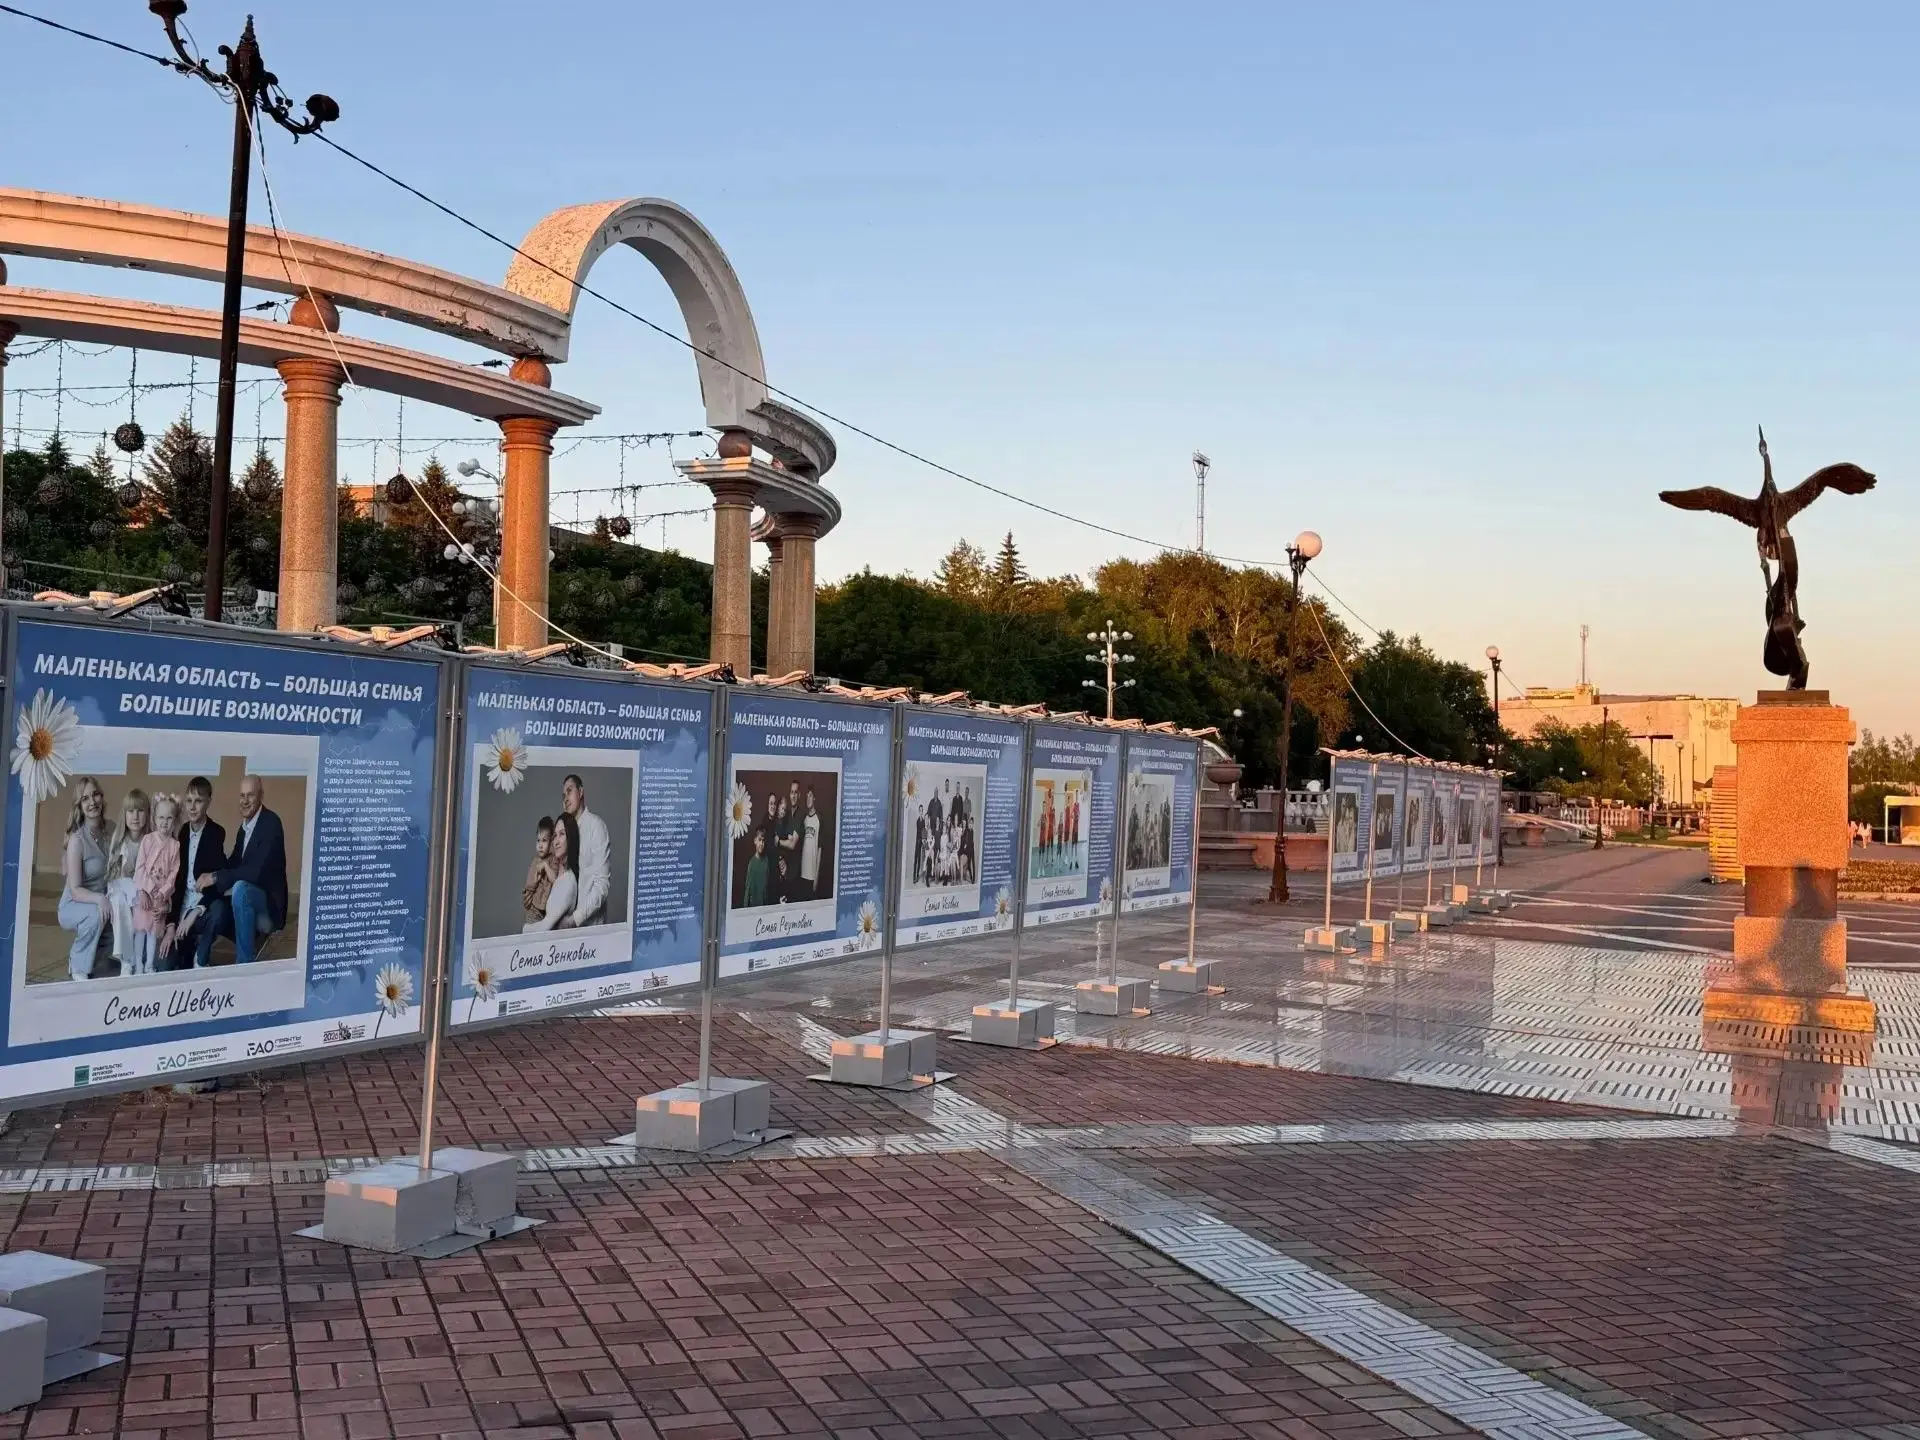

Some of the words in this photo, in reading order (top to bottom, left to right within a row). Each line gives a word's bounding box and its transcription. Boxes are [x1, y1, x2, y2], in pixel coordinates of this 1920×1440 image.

[33, 653, 171, 683] МАЛЕНЬКАЯ
[174, 666, 261, 690] ОБЛАСТЬ
[284, 675, 369, 698] БОЛЬШАЯ
[372, 683, 423, 702] СЕМЬЯ
[119, 693, 222, 718] БОЛЬШИЕ
[224, 700, 362, 725] ВОЗМОЖНОСТИ
[477, 691, 555, 713] МАЛЕНЬКАЯ
[556, 698, 606, 716] ОБЛАСТЬ
[618, 703, 669, 721] БОЛЬШАЯ
[671, 707, 702, 723] СЕМЬЯ
[524, 720, 583, 737] БОЛЬШИЕ
[585, 723, 665, 742] ВОЗМОЖНОСТИ
[734, 712, 785, 727] МАЛЕНЬКАЯ
[786, 717, 820, 730] ОБЛАСТЬ
[827, 720, 862, 733] БОЛЬШАЯ
[863, 723, 884, 735] СЕМЬЯ
[765, 734, 804, 748] БОЛЬШИЕ
[805, 737, 860, 751] ВОЗМОЖНОСТИ
[908, 726, 945, 739] МАЛЕНЬКАЯ
[946, 730, 971, 741] ОБЛАСТЬ
[976, 733, 1002, 744] БОЛЬШАЯ
[1003, 736, 1019, 745] СЕМЬЯ
[1035, 739, 1063, 749] МАЛЕНЬКАЯ
[930, 745, 959, 757] БОЛЬШИЕ
[960, 747, 1001, 759] ВОЗМОЖНОСТИ
[325, 758, 351, 767] Супруги
[350, 911, 376, 919] Супруги
[377, 908, 410, 916] Александр
[315, 921, 365, 931] Александрович
[756, 918, 777, 936] Семья
[314, 942, 337, 951] наград
[345, 936, 406, 949] профессиональную
[510, 949, 542, 972] Семья
[546, 942, 597, 966] Зенковых
[104, 996, 161, 1026] Семья
[167, 988, 235, 1017] Шевчук
